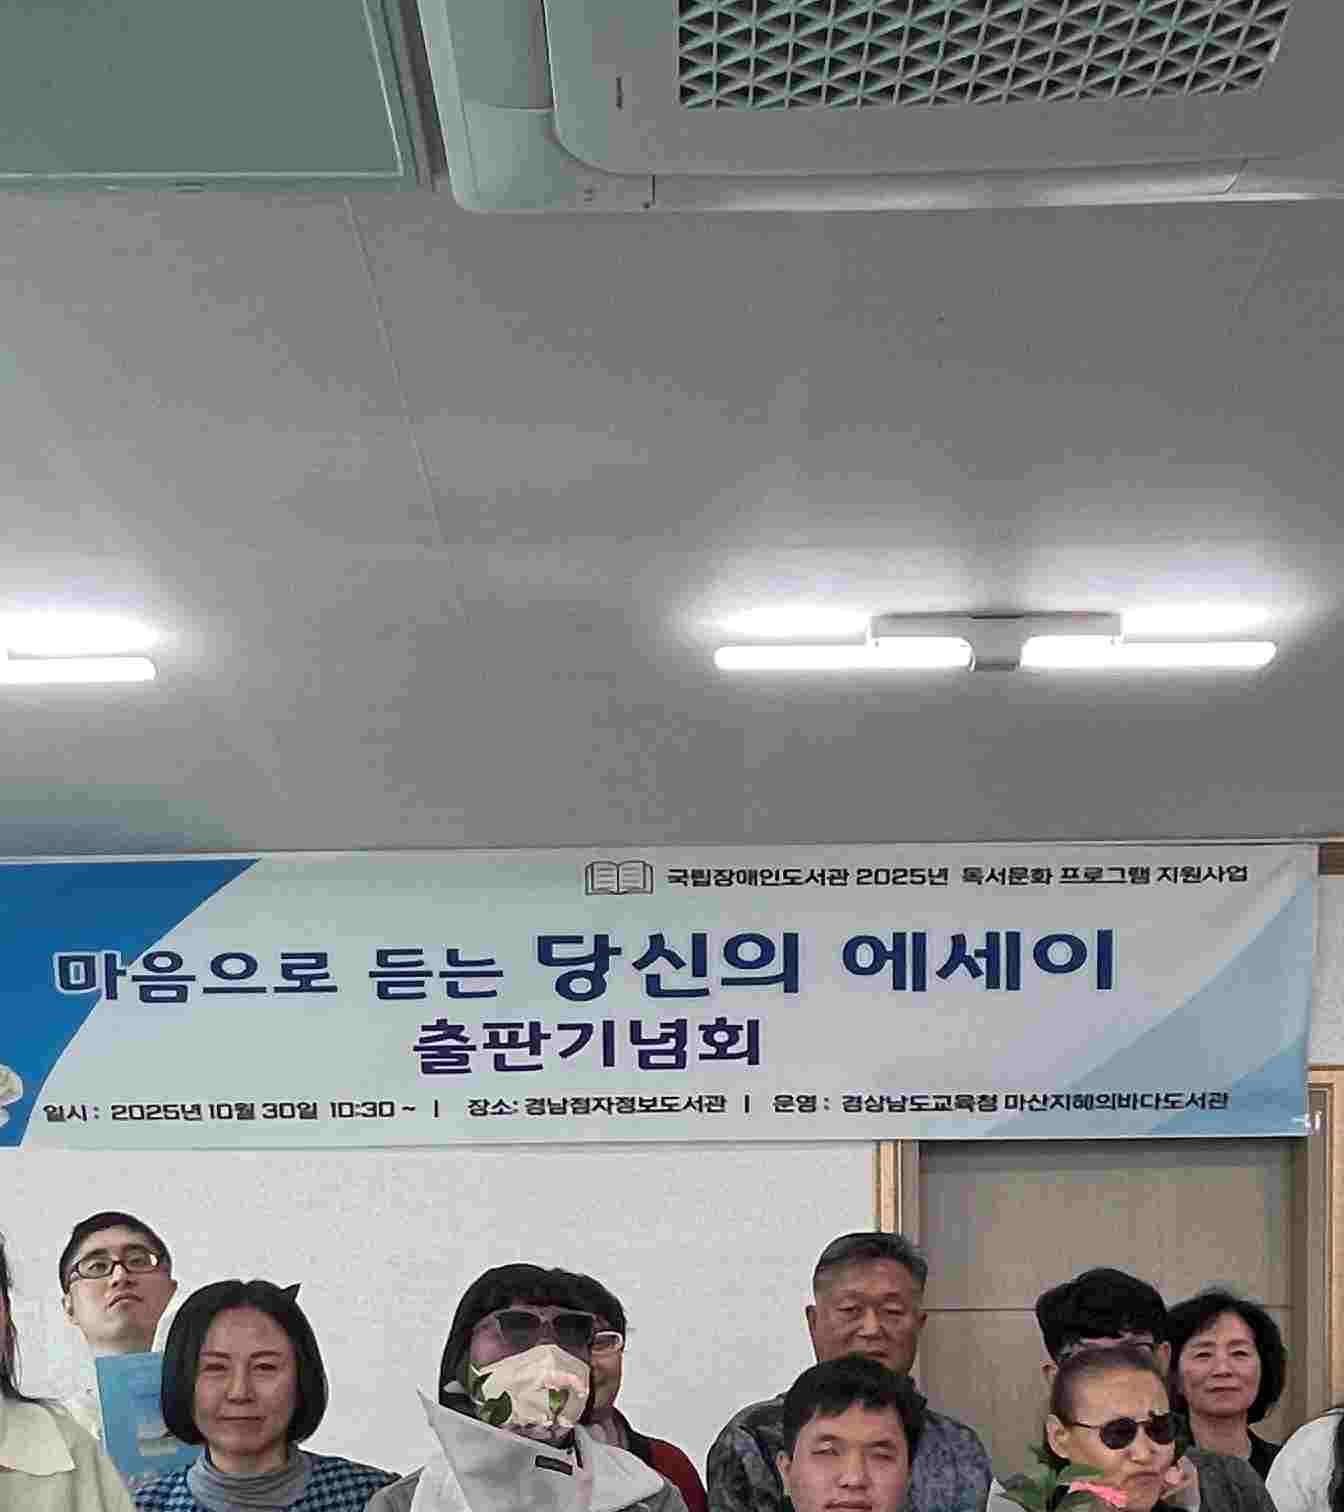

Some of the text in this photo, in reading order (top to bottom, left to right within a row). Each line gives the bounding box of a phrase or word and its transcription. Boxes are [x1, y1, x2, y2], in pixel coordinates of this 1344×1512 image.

[667, 865, 1248, 888] 국립장애인도서관 2025년 독서문화 프로그램 지원사업
[56, 929, 1113, 1004] 마음으로 듣는 당신의 에세이
[412, 1016, 760, 1075] 출판기념회
[110, 1103, 202, 1122] 2025년
[208, 1102, 255, 1121] 10월
[261, 1101, 318, 1120] 30일
[842, 1093, 998, 1113] 경상남도교육청
